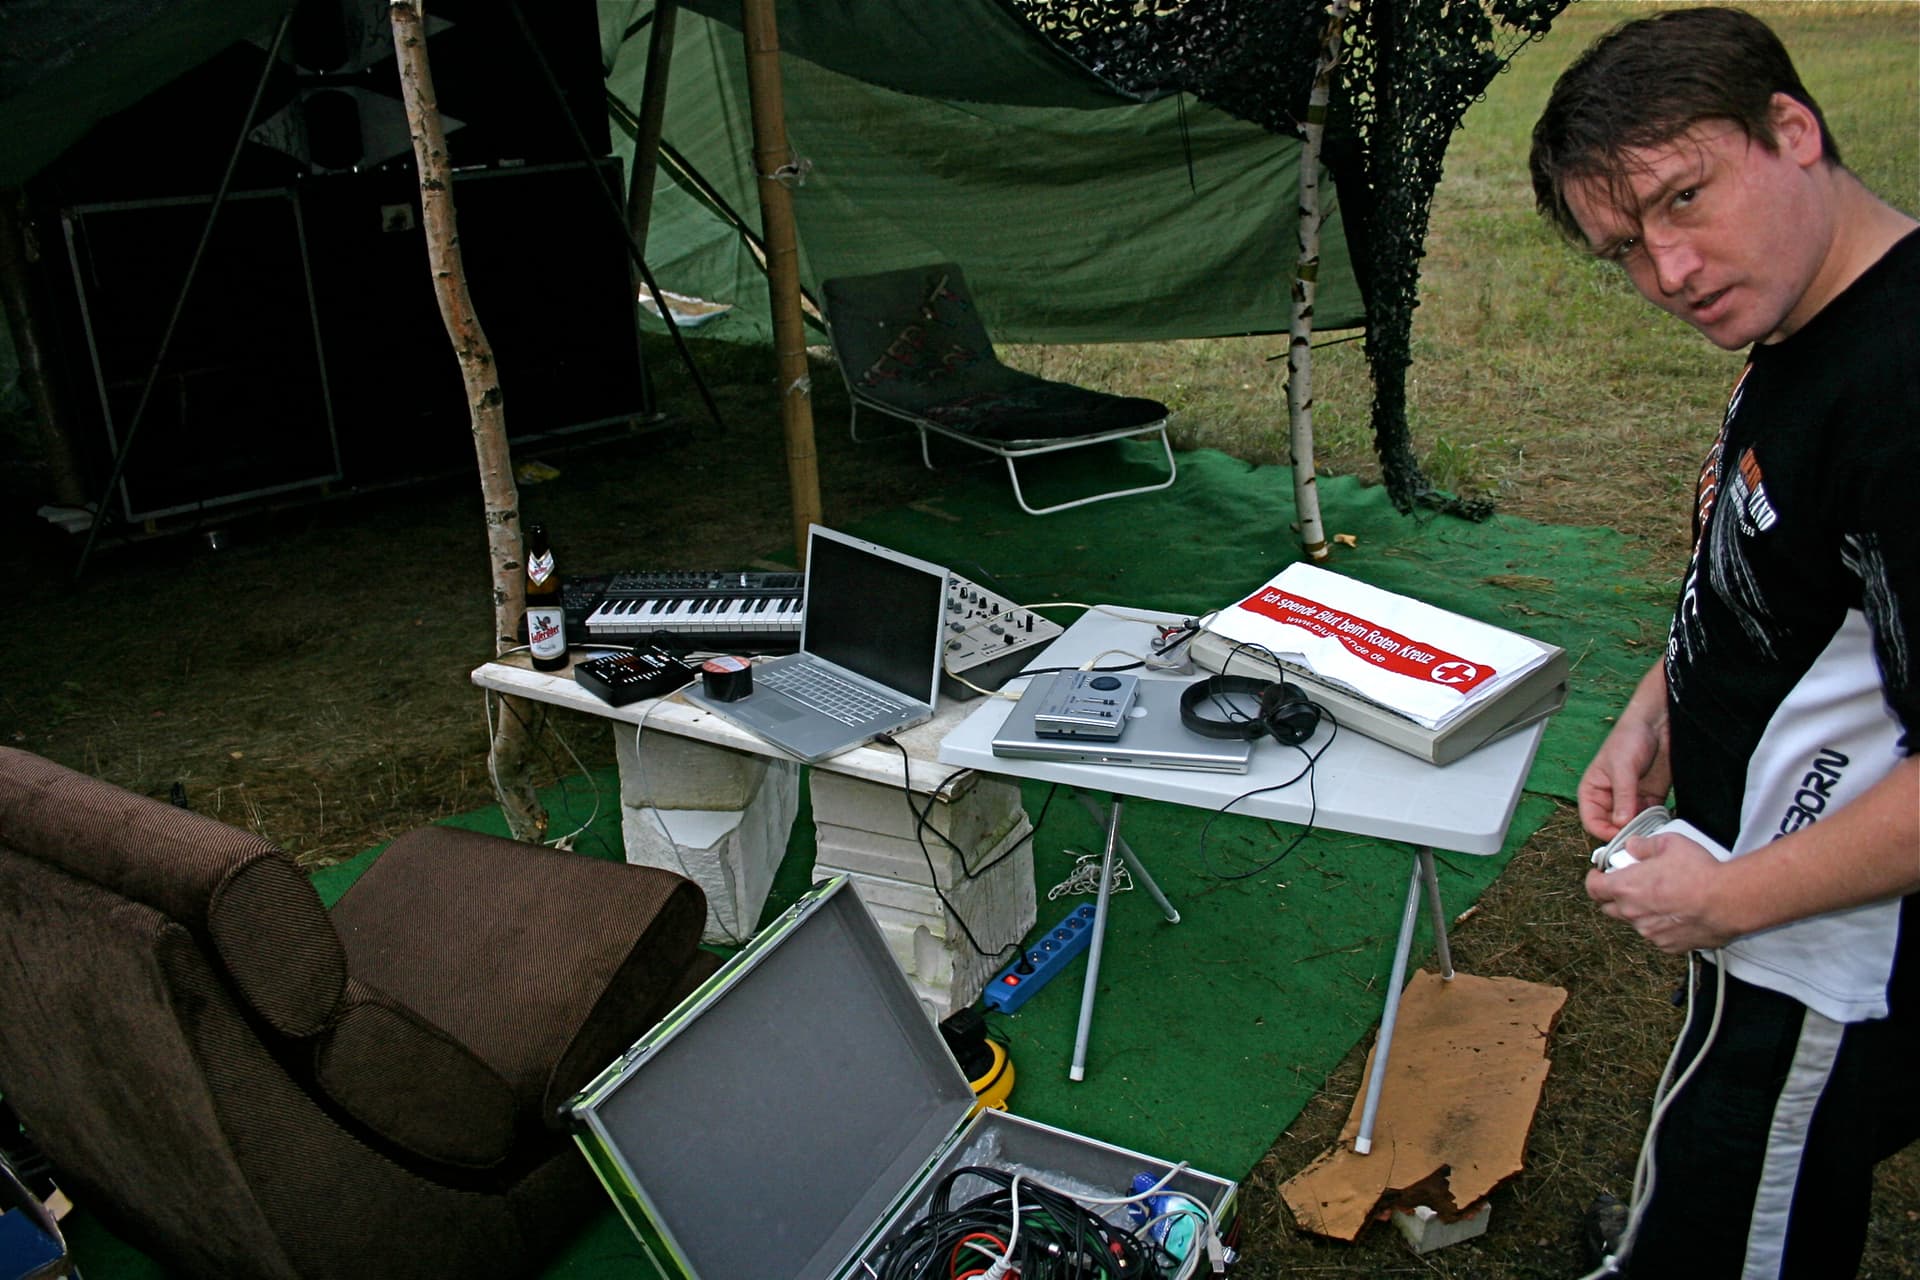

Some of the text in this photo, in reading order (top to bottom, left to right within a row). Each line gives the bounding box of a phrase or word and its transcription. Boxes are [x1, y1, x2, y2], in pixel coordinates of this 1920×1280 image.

[1260, 591, 1436, 665] Ich spende Blut beim Roten Kreuz
[1769, 747, 1850, 842] EBORN
